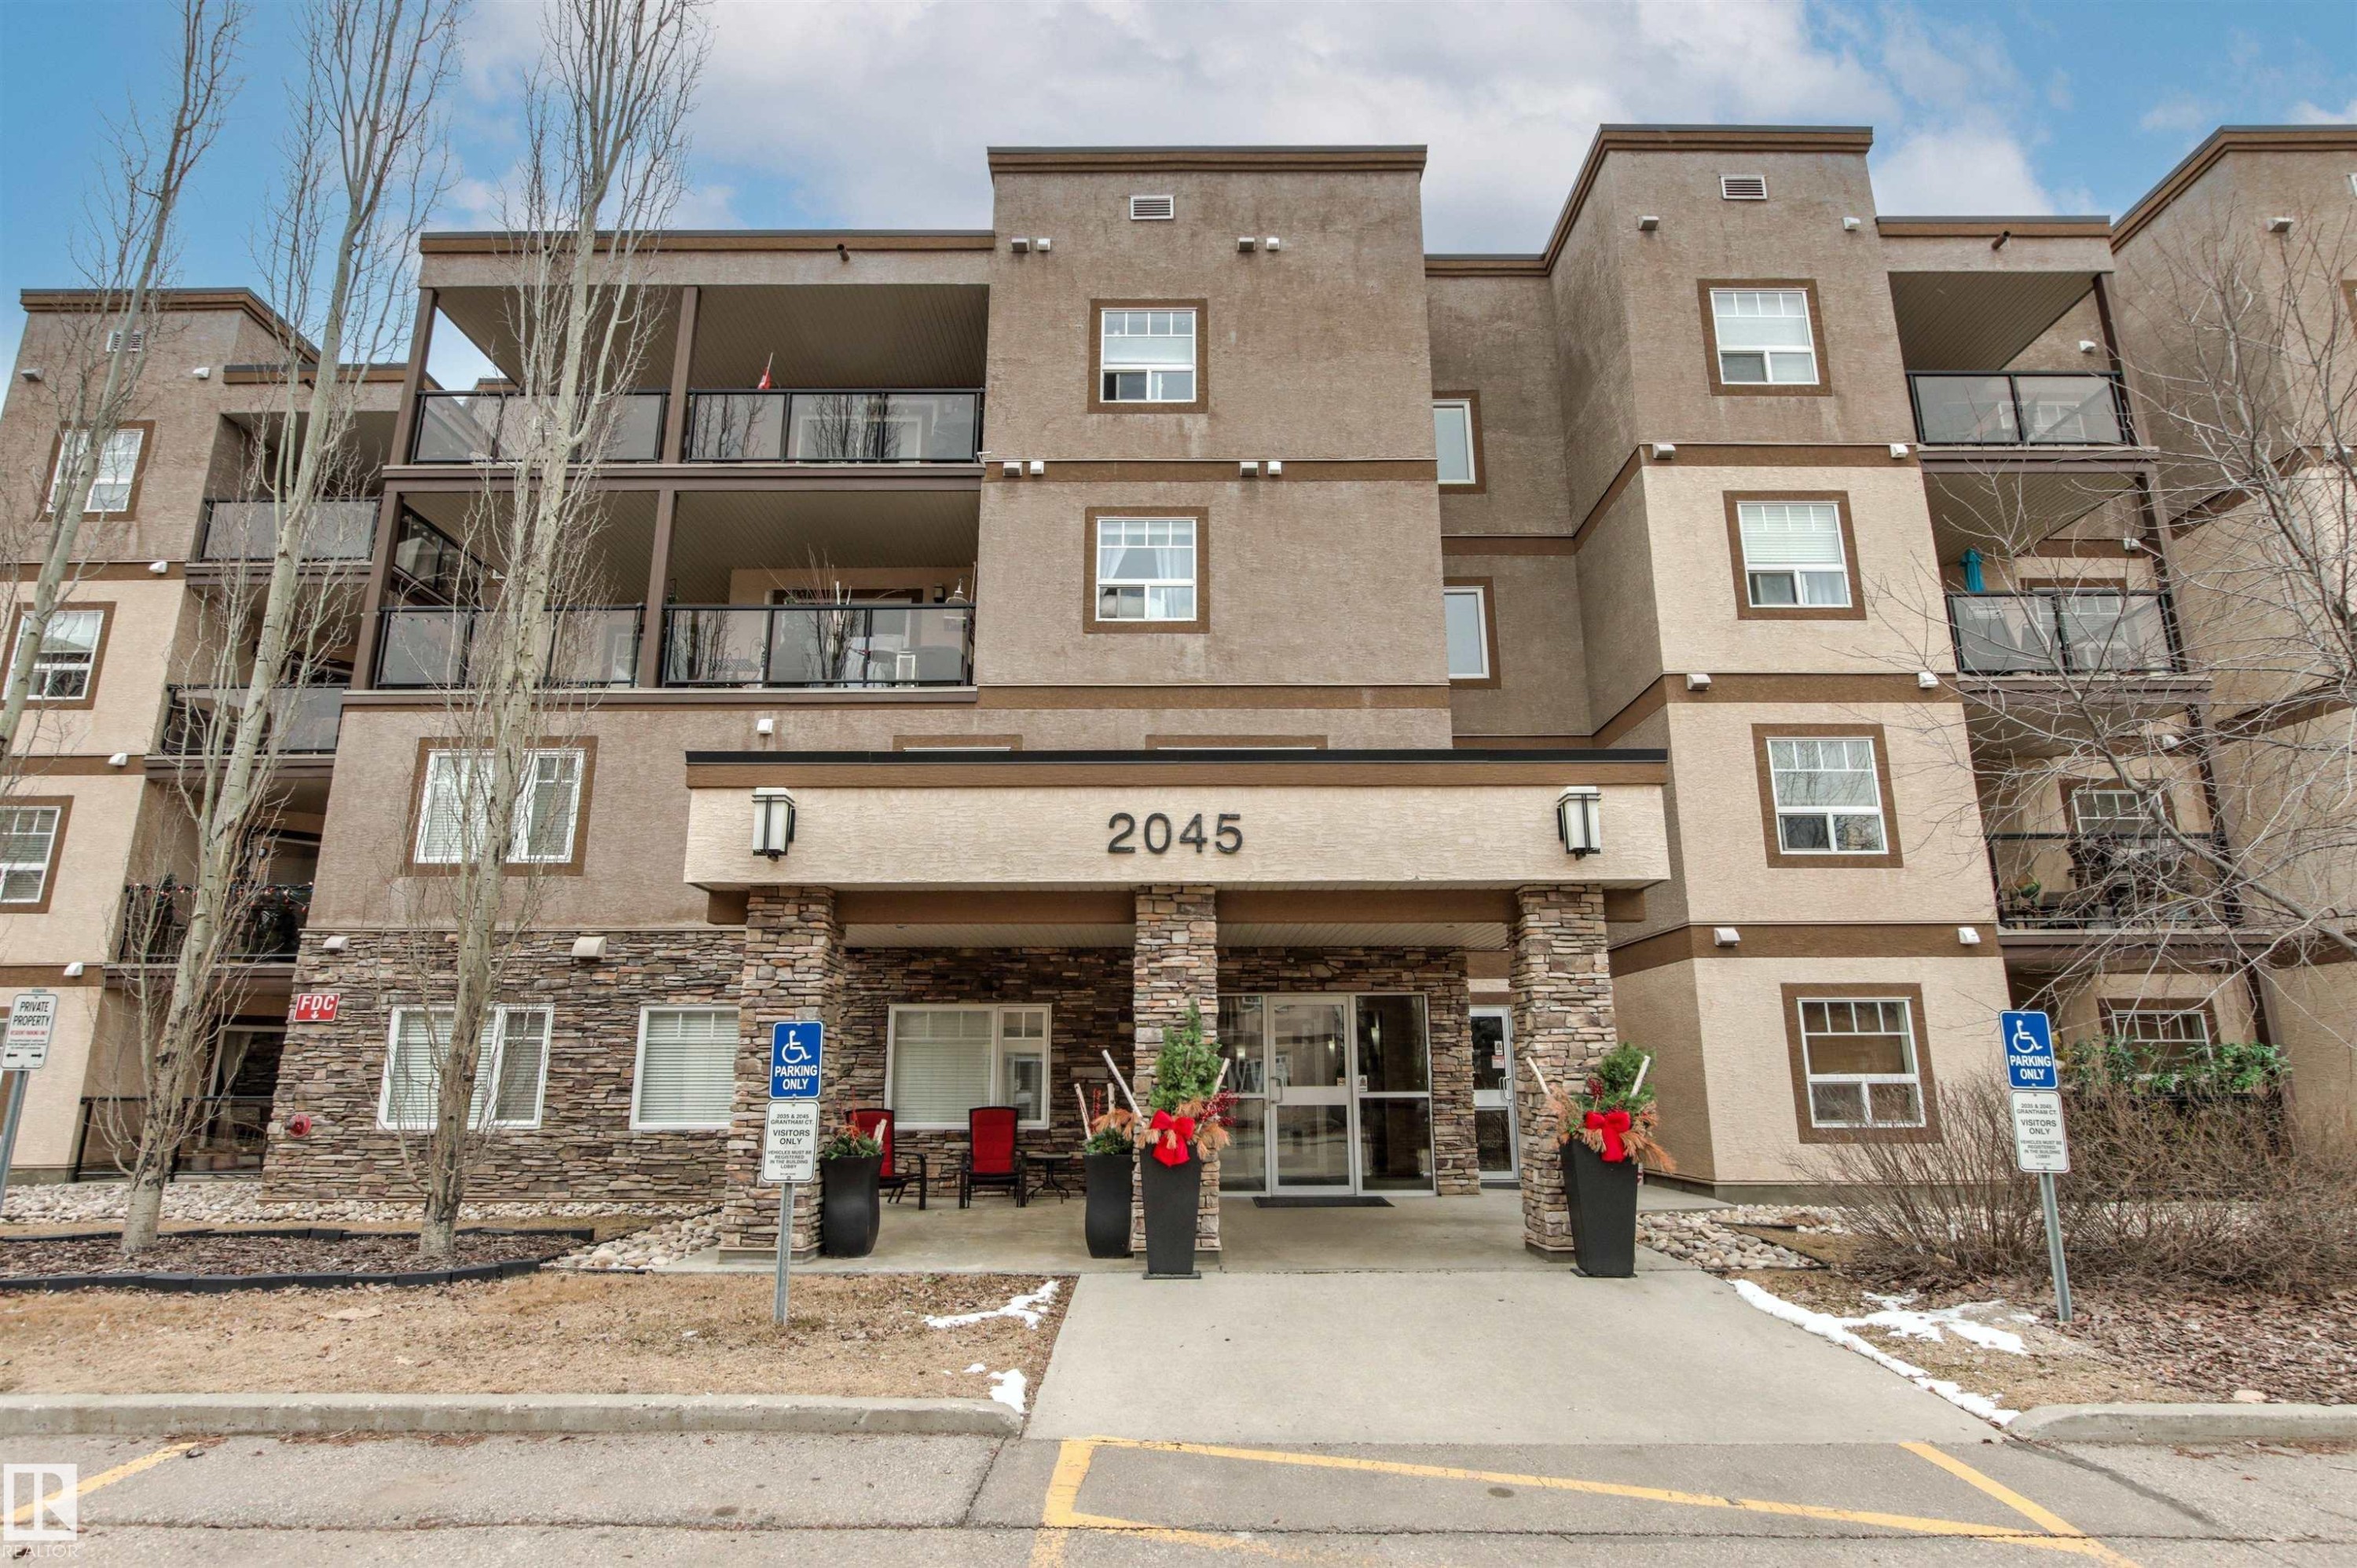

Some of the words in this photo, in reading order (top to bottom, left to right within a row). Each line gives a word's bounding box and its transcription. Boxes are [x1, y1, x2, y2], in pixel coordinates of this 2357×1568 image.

[1108, 812, 1243, 854] 2045
[20, 1002, 49, 1012] PRIVATE
[300, 995, 335, 1010] FDC
[13, 1016, 50, 1026] PROPERTY
[2009, 1055, 2051, 1067] PARKING
[775, 1065, 818, 1077] PARKING
[2020, 1068, 2044, 1080] ONLY
[783, 1079, 808, 1090] ONLY
